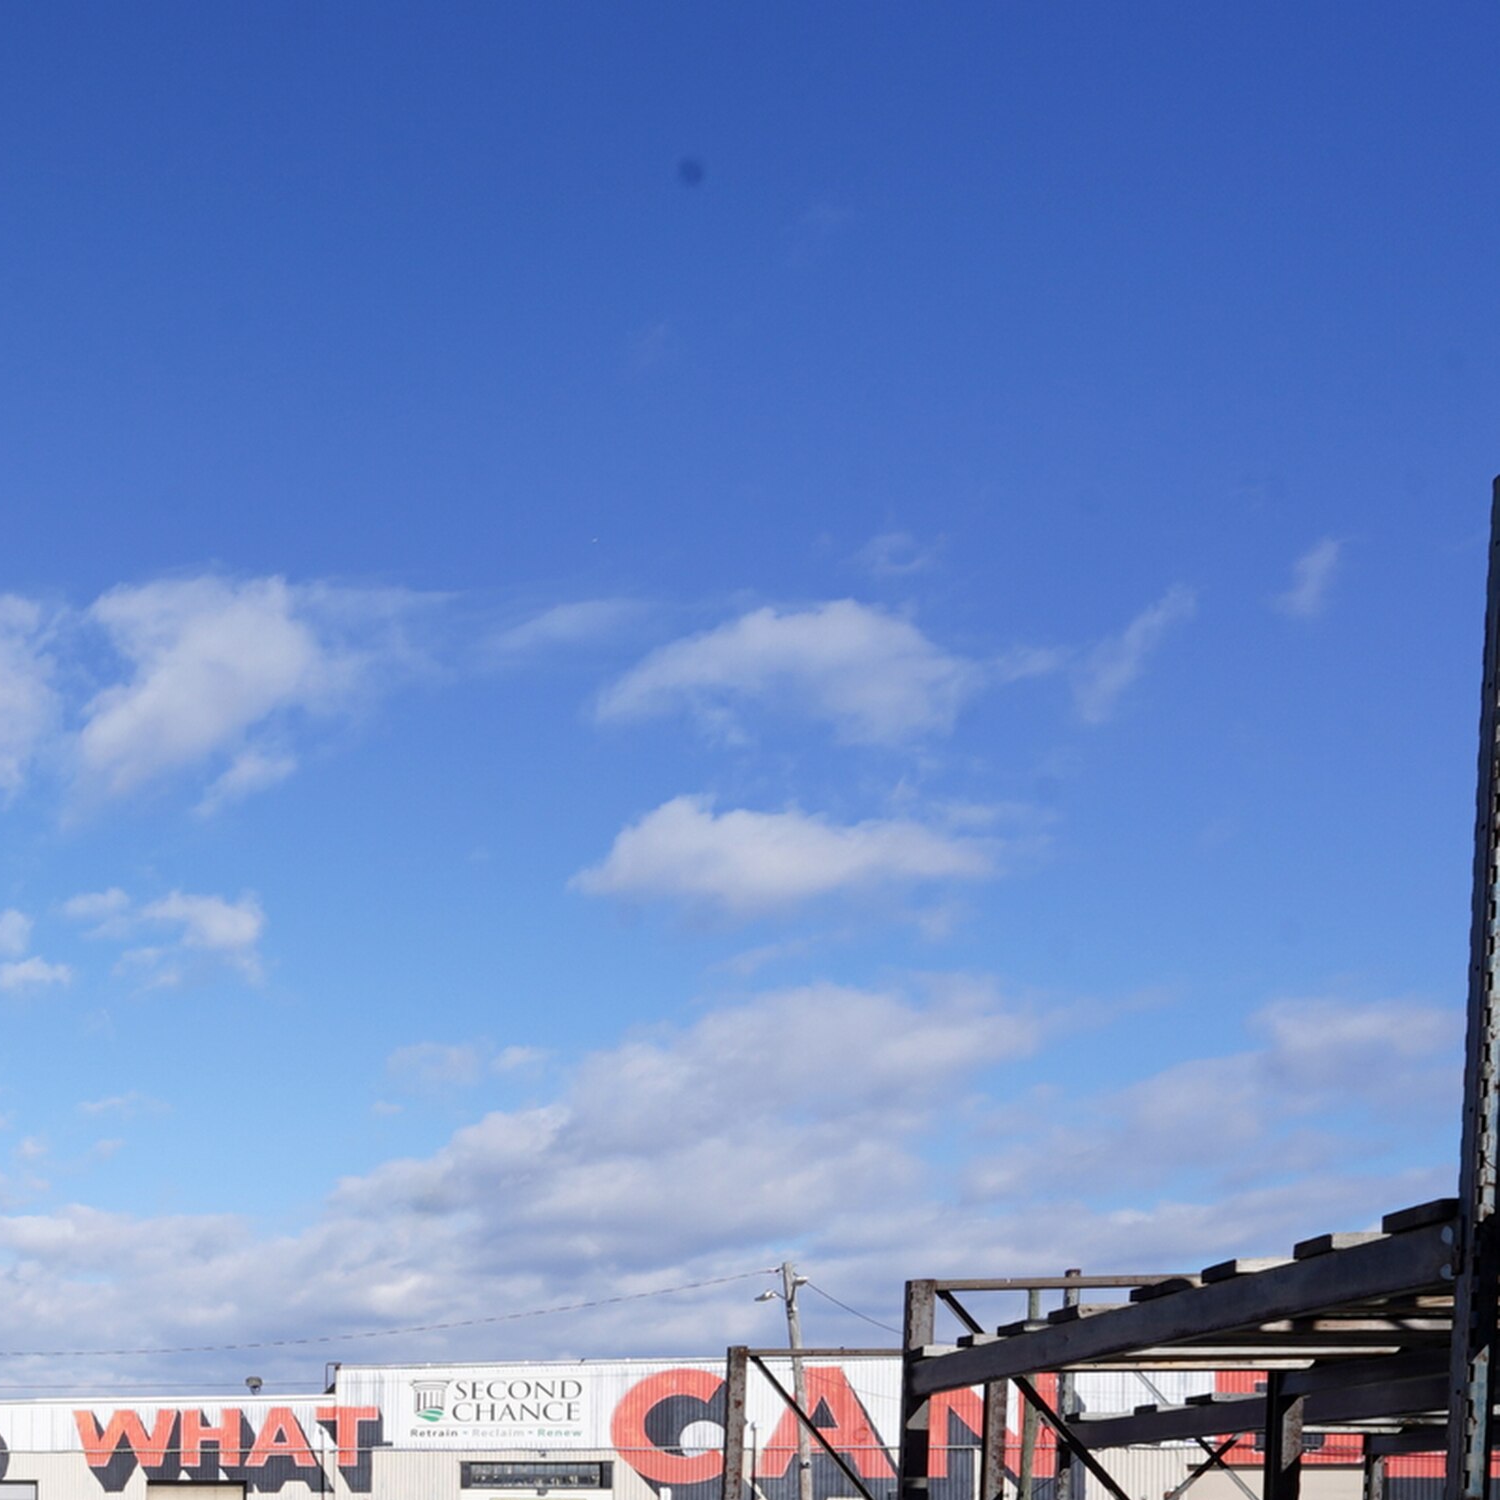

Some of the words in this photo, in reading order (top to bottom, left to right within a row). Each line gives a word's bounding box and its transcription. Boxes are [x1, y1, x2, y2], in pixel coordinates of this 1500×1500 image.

[453, 1380, 583, 1401] SECOND
[451, 1402, 582, 1422] CHANCE
[74, 1406, 380, 1468] WHAT
[410, 1428, 458, 1438] Retrain
[471, 1428, 525, 1438] Reclaim
[537, 1428, 583, 1438] Renew
